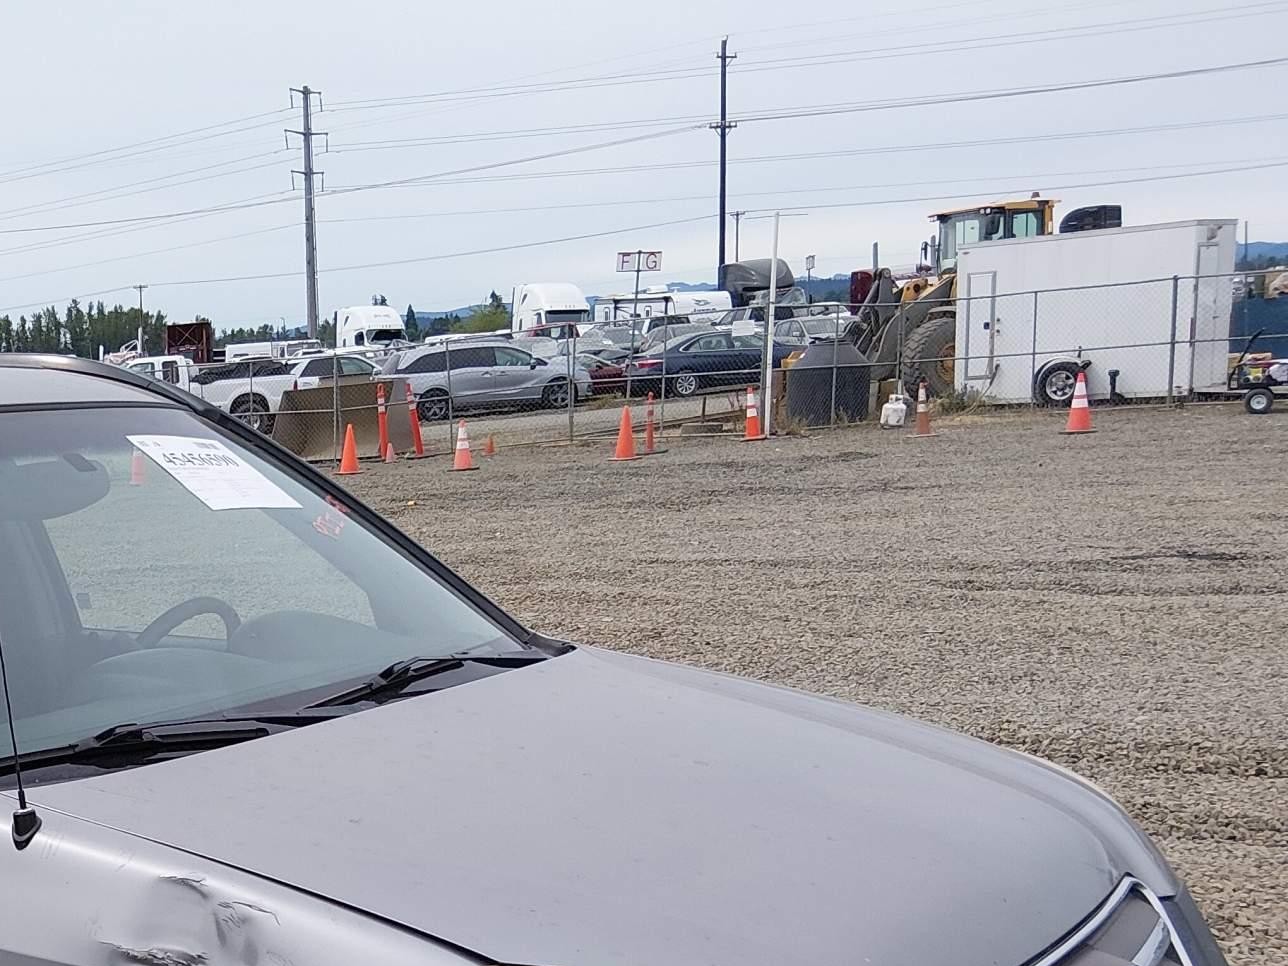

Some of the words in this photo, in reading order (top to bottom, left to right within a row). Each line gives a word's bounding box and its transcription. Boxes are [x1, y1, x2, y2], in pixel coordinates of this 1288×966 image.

[621, 253, 632, 270] F
[645, 252, 658, 270] G
[161, 452, 240, 468] 45456590
